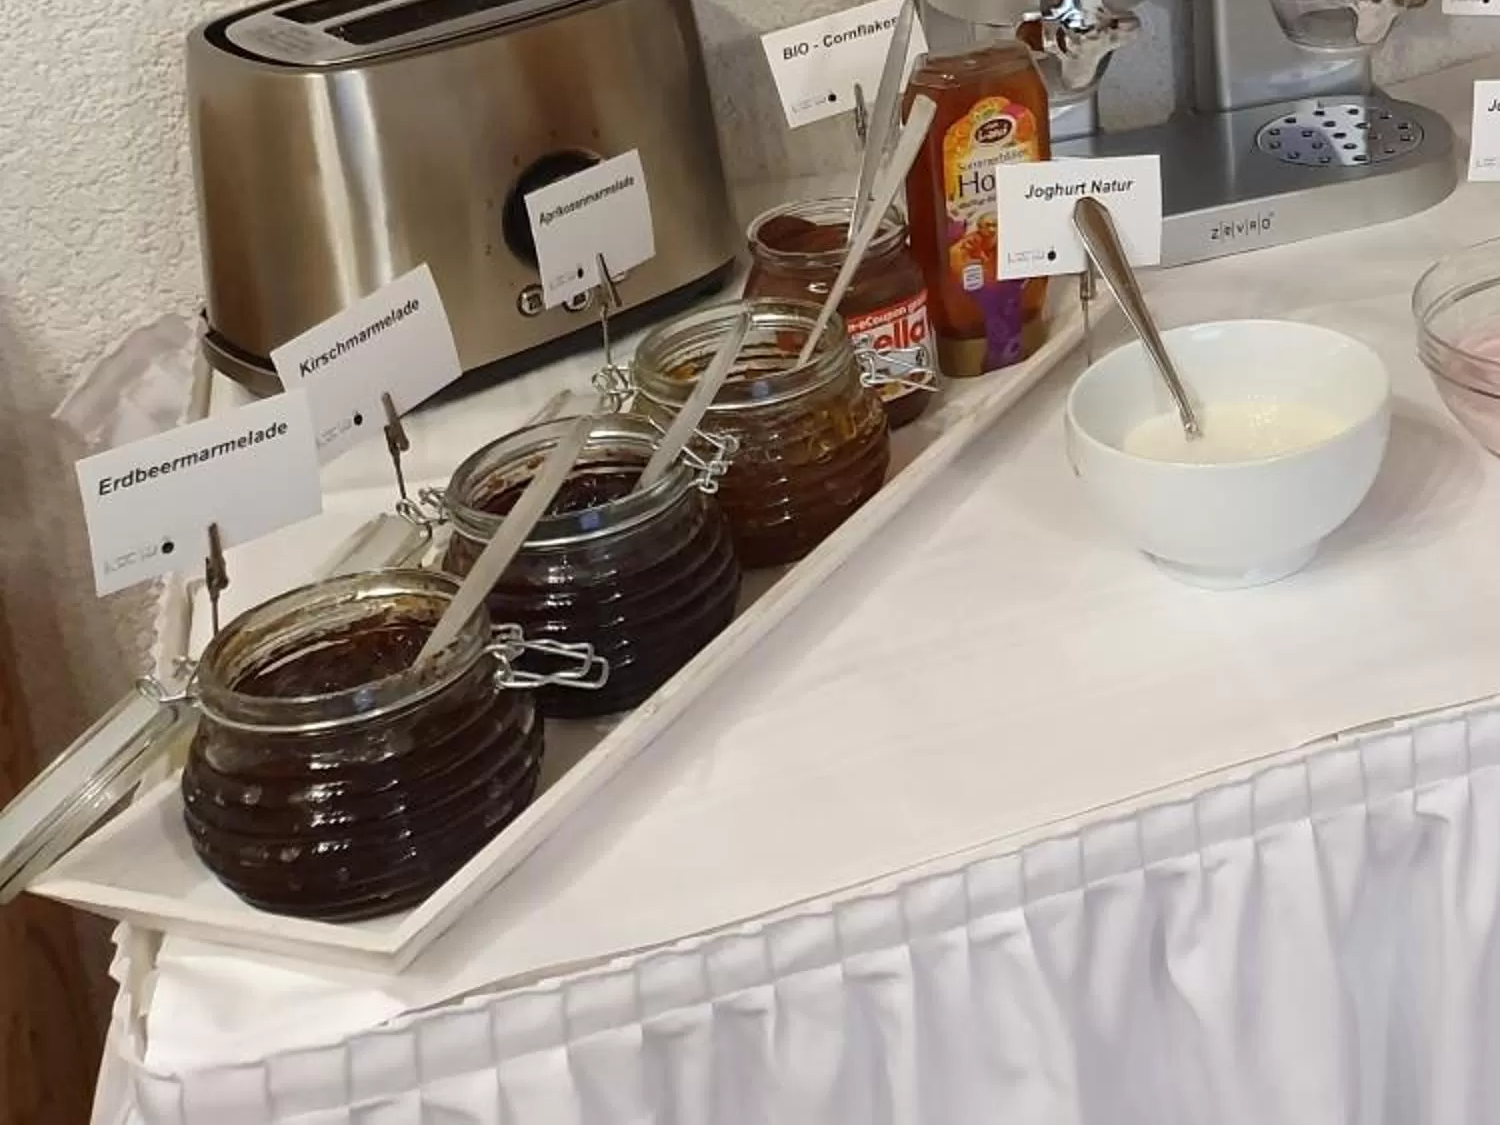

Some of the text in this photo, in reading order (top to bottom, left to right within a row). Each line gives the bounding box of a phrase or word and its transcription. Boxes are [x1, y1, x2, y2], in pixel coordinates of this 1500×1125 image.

[783, 41, 809, 60] BIO
[539, 175, 636, 227] Aprikosenmarmelade
[1025, 179, 1135, 201] Joghurt Natur
[299, 298, 420, 378] Kirschmarmelade
[873, 318, 927, 350] ella
[98, 421, 289, 496] Erdbeermarmelade
